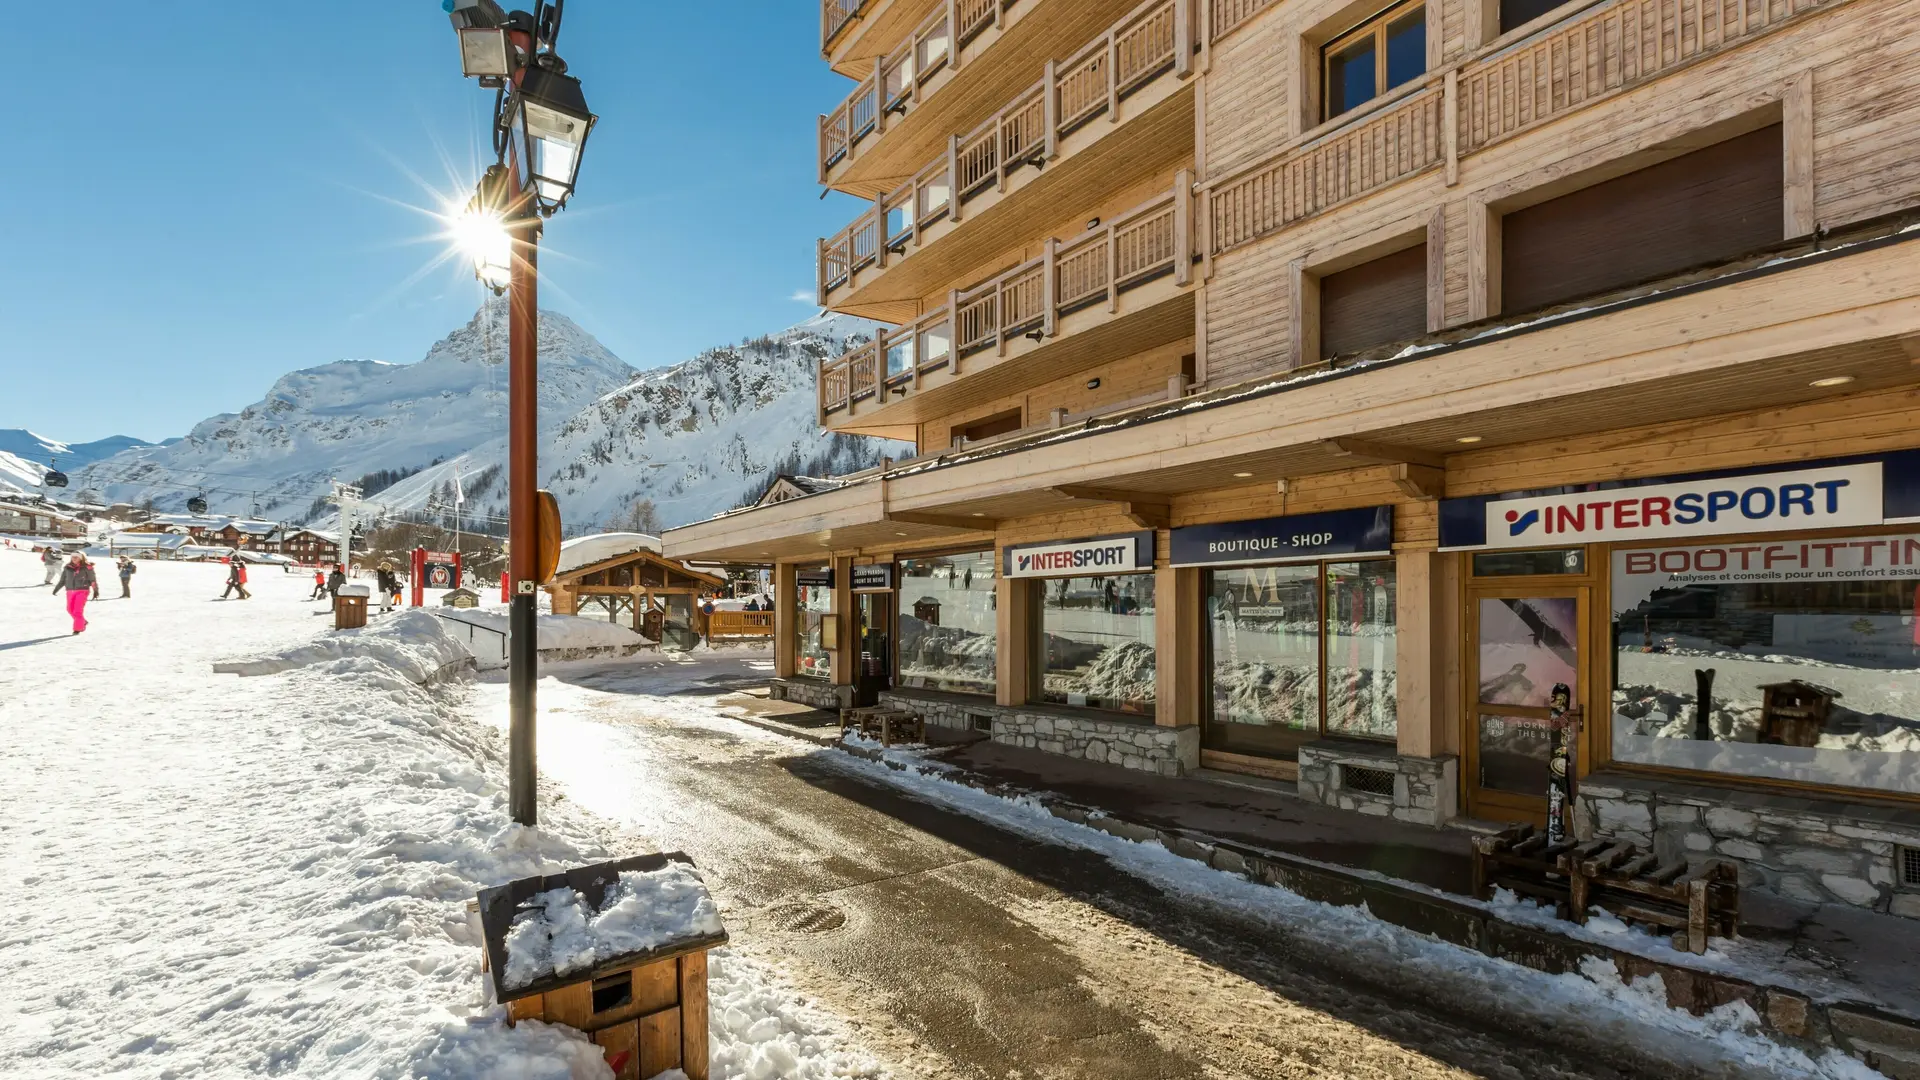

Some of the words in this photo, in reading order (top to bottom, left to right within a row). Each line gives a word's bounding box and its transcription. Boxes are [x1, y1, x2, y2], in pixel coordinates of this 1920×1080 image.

[1545, 479, 1850, 534] INTERSPORT
[1209, 537, 1278, 553] BOUTIQUE
[1291, 532, 1333, 547] SHOP
[1031, 546, 1126, 570] INTERSPORT
[1240, 567, 1282, 603] M
[1668, 573, 1716, 582] Analyses
[1719, 573, 1730, 581] et
[1733, 571, 1782, 581] conseils
[1785, 571, 1813, 580] pour
[1817, 570, 1833, 578] un
[1837, 568, 1885, 577] confort
[1517, 721, 1546, 729] BORN
[1517, 730, 1535, 738] THE
